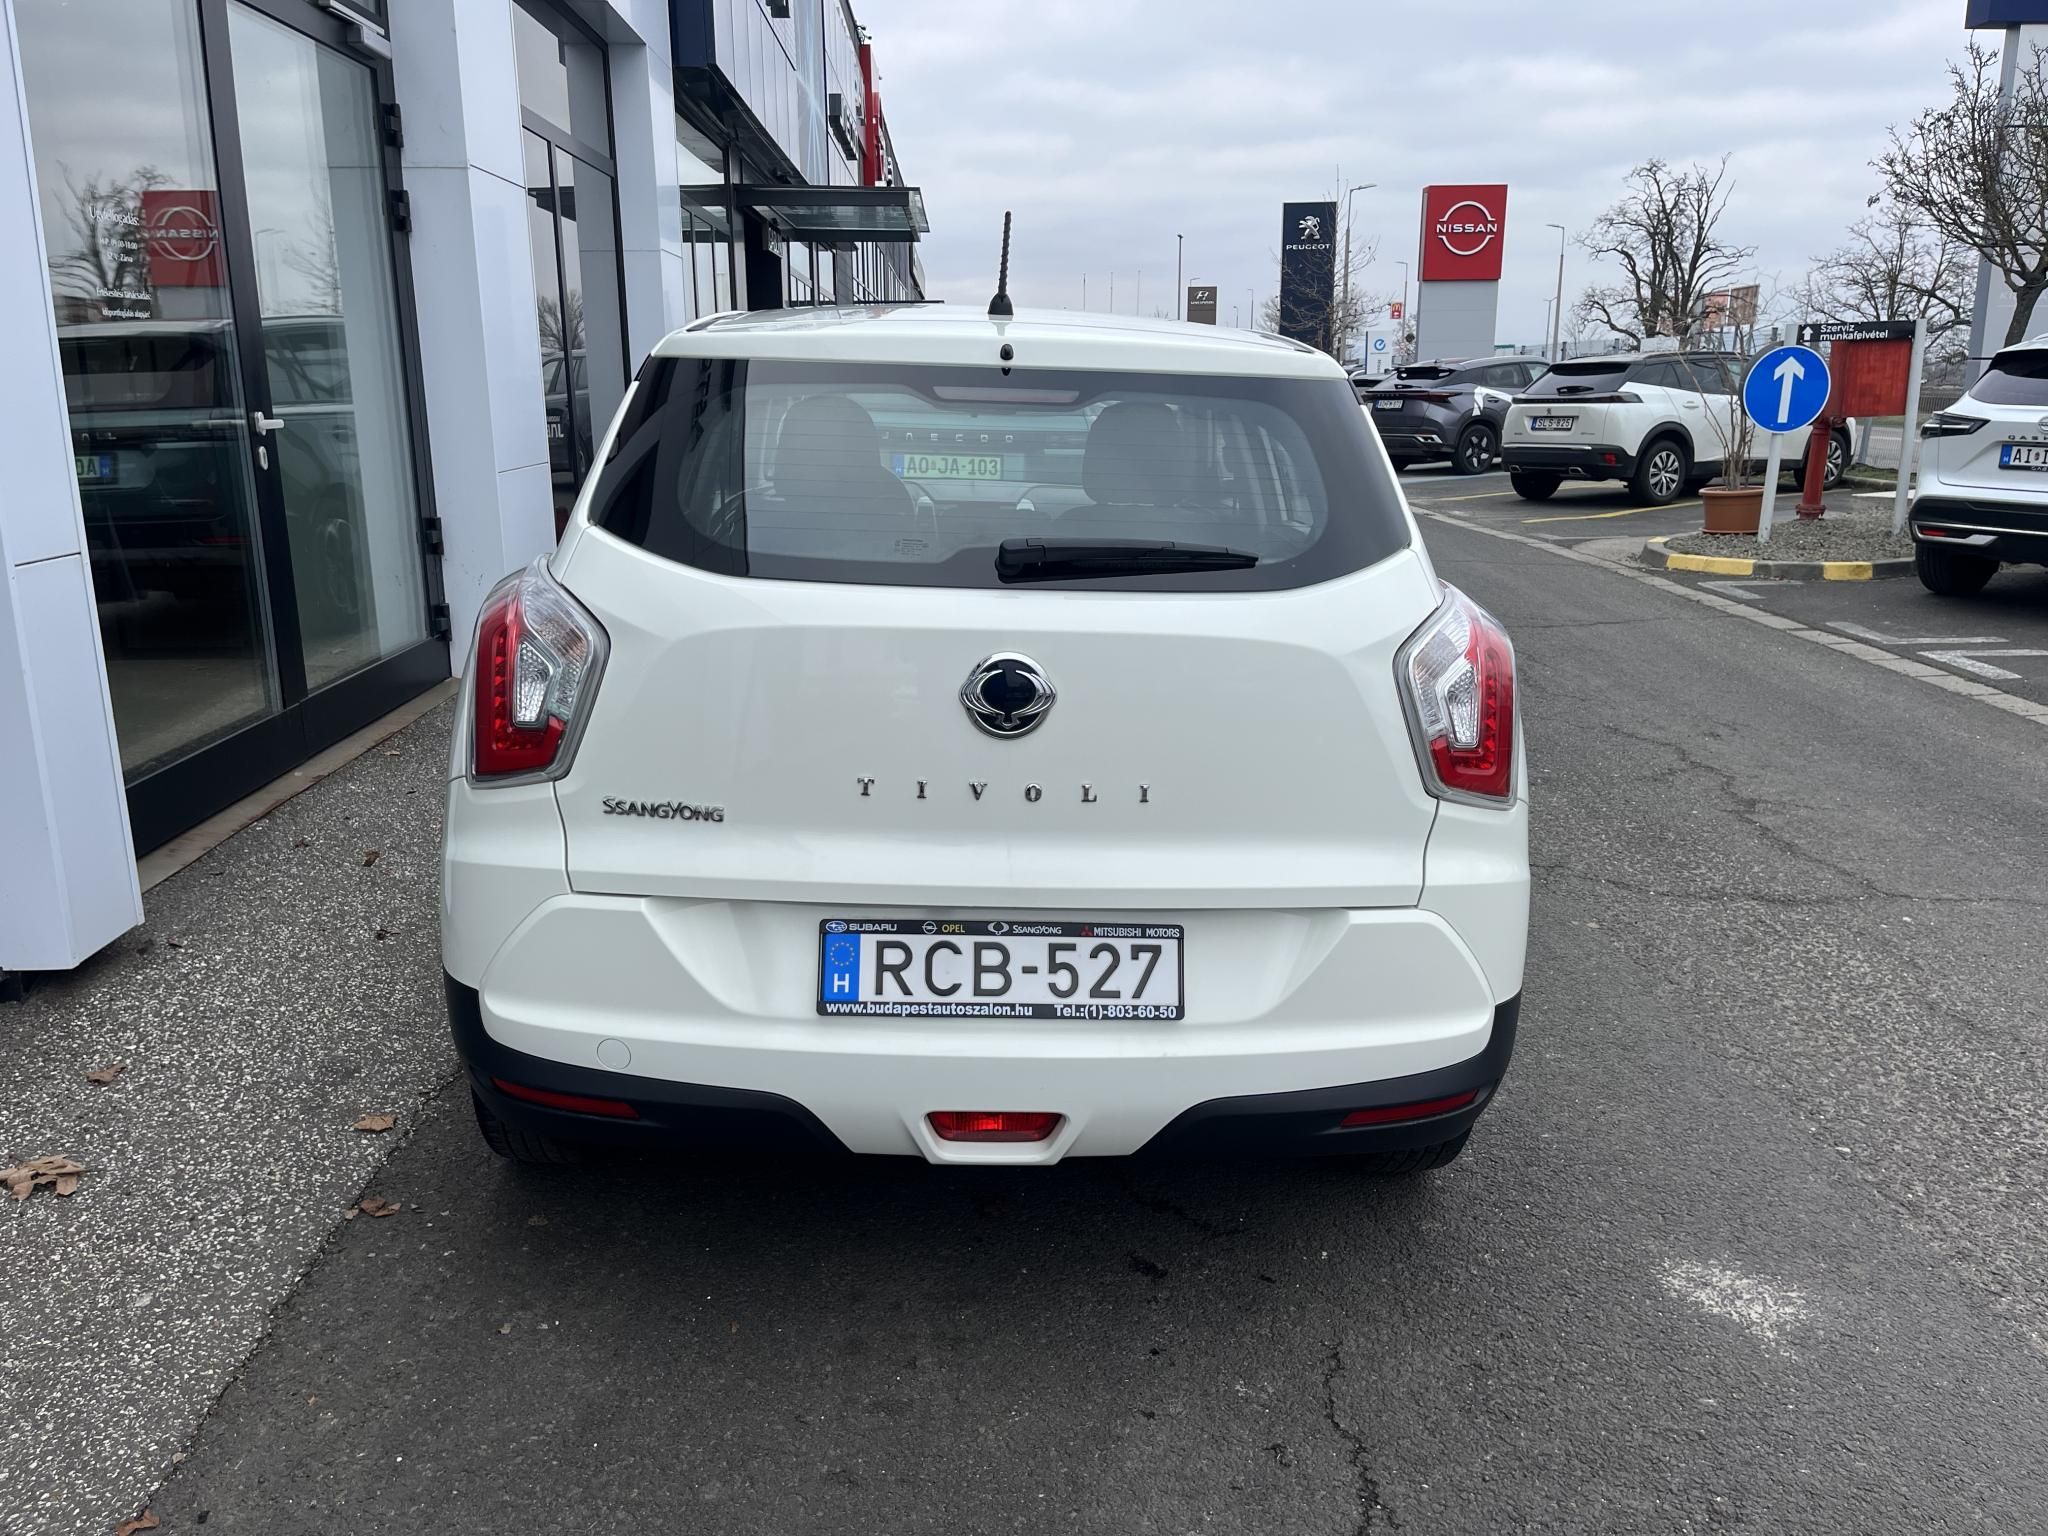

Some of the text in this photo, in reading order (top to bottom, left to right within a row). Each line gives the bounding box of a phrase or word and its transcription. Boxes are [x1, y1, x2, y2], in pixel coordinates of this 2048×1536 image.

[1436, 223, 1498, 233] NISSAN
[1820, 325, 1855, 333] Szerviz
[1820, 330, 1889, 341] munkafelvétel
[857, 777, 1151, 803] TIVOLI
[848, 922, 898, 932] SUBARU
[941, 924, 966, 933] OPEL
[1093, 926, 1180, 937] MITSUBISHI MOTORS
[875, 940, 1162, 999] RCB-527
[833, 973, 849, 993] H
[826, 1002, 1033, 1017] www.budapestautoszalon.hu
[1054, 1004, 1177, 1019] Tel.:(1)-803-60-50
